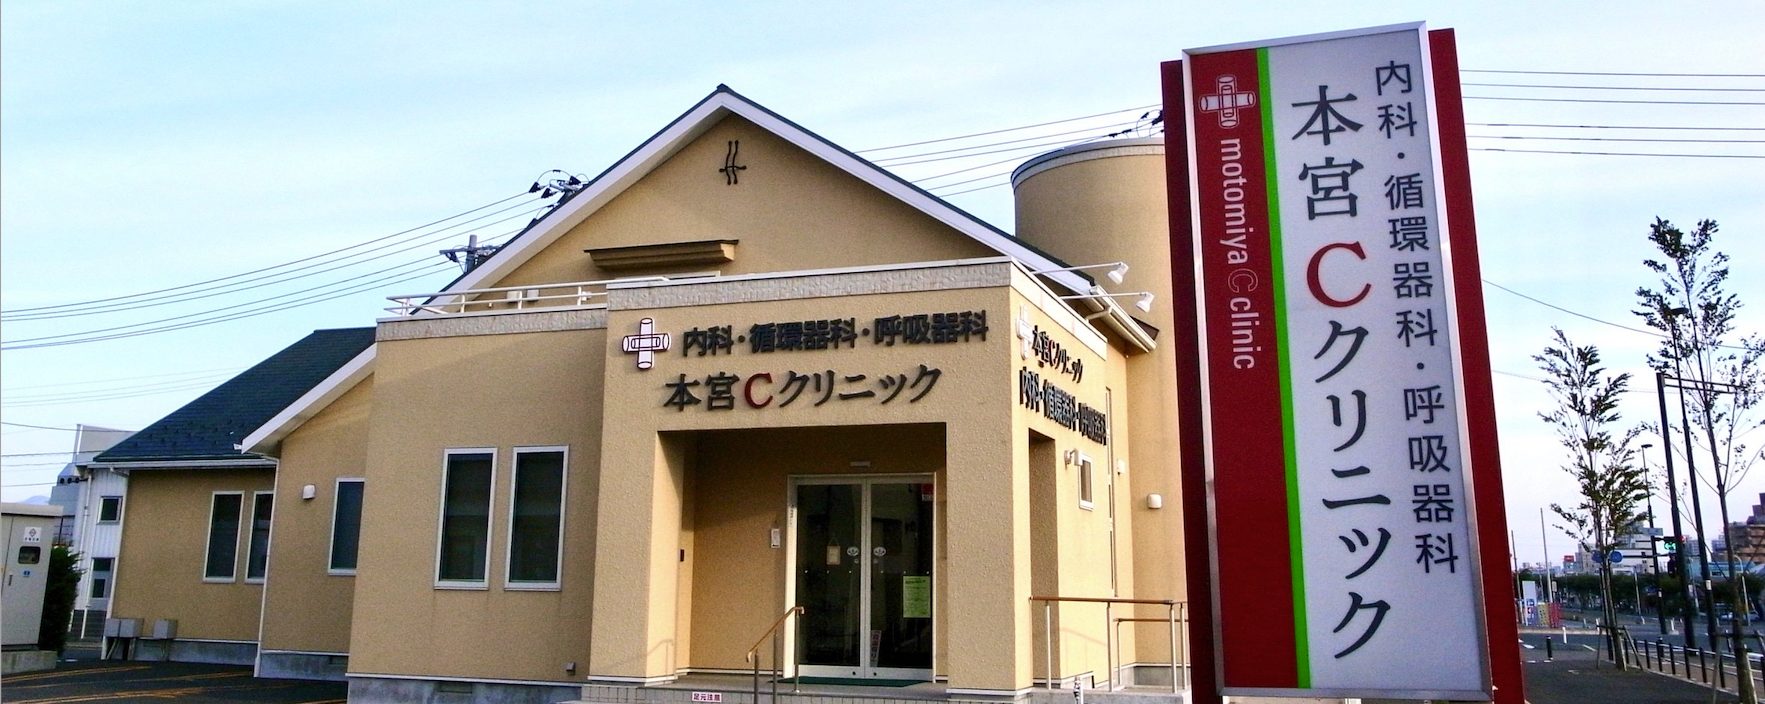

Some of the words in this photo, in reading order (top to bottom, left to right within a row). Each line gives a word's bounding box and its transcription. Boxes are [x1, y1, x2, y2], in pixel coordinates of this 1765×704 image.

[1220, 138, 1254, 265] motomiya
[1230, 297, 1262, 369] clinic
[1291, 85, 1392, 659] 本宮Cクリニック
[1375, 60, 1459, 574] 内科・循環器科・呼吸器科
[664, 364, 942, 412] 本宮Cクリニック
